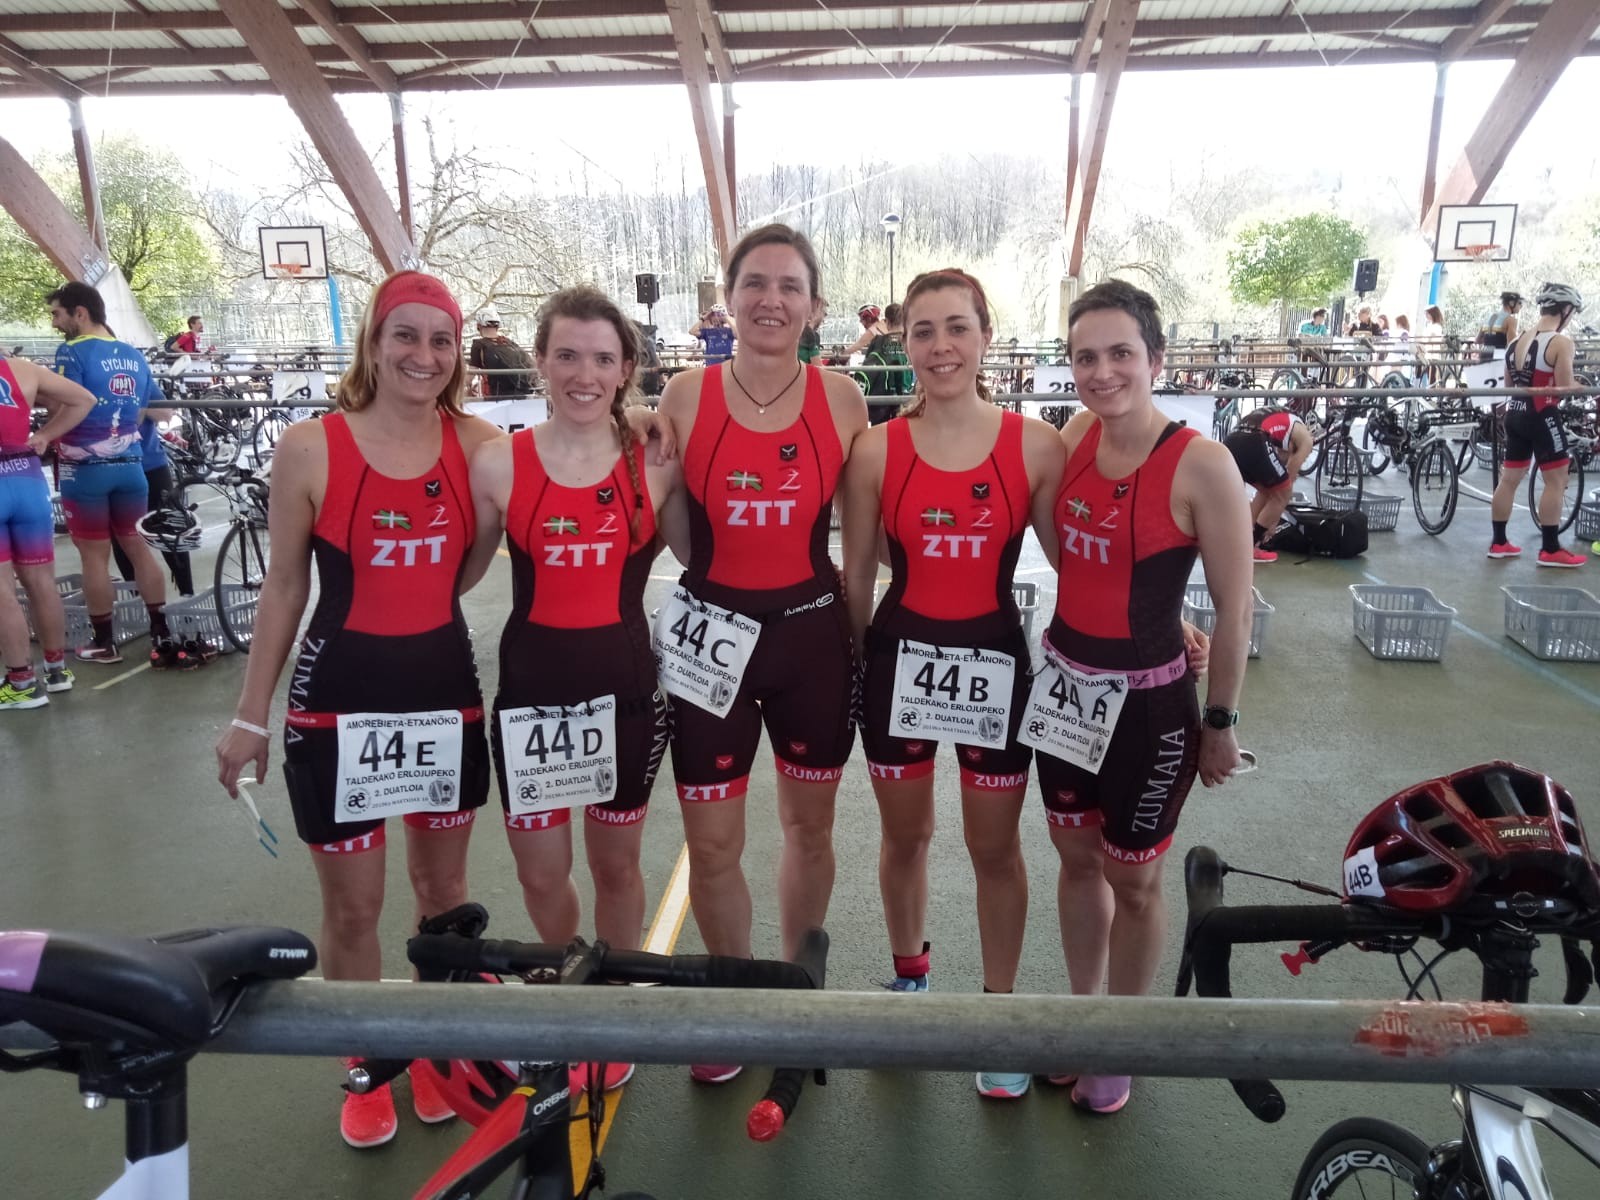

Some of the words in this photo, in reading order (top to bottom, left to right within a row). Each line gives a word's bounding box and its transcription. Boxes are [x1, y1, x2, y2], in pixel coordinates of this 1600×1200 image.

[101, 359, 139, 372] CYCLING
[727, 500, 796, 526] ZTT
[370, 535, 447, 566] ZTT
[544, 542, 613, 567] ZTT
[922, 535, 987, 558] ZTT
[1063, 524, 1111, 564] ZTT
[670, 610, 709, 657] 44
[710, 638, 736, 668] C
[906, 647, 1011, 666] AMOREETA-ETXANOKO
[677, 665, 709, 687] DUATLOIA
[693, 658, 738, 684] ERLOJUPEKO
[913, 662, 961, 701] 44
[969, 676, 989, 703] B
[287, 636, 326, 744] ZUMAA
[1049, 673, 1083, 718] 44
[1091, 698, 1108, 724] A
[900, 696, 948, 710] TALDEKAKO
[950, 703, 1005, 716] ERLOJUPEKO
[1033, 703, 1077, 726] TALDEKAKO
[346, 717, 459, 730] AMOREBIETA-ETXANOKO
[935, 714, 974, 726] DUATLOIA
[359, 731, 407, 772] 44
[416, 741, 436, 766] E
[525, 721, 575, 764] 44
[582, 728, 603, 756] D
[345, 772, 396, 786] TALDEKAKO
[397, 769, 456, 779] ERLOJUPEKO
[514, 763, 566, 778] TALDEKAKO
[569, 756, 612, 770] ERLOJUPEKO
[384, 784, 424, 796] DUATLOIA
[555, 775, 592, 787] DUATLOIA
[1131, 727, 1185, 832] ZUMAIA
[683, 784, 730, 800] ZTT
[507, 812, 552, 829] ZTT
[1349, 864, 1373, 893] 44B
[1307, 1150, 1399, 1200] RBEA
